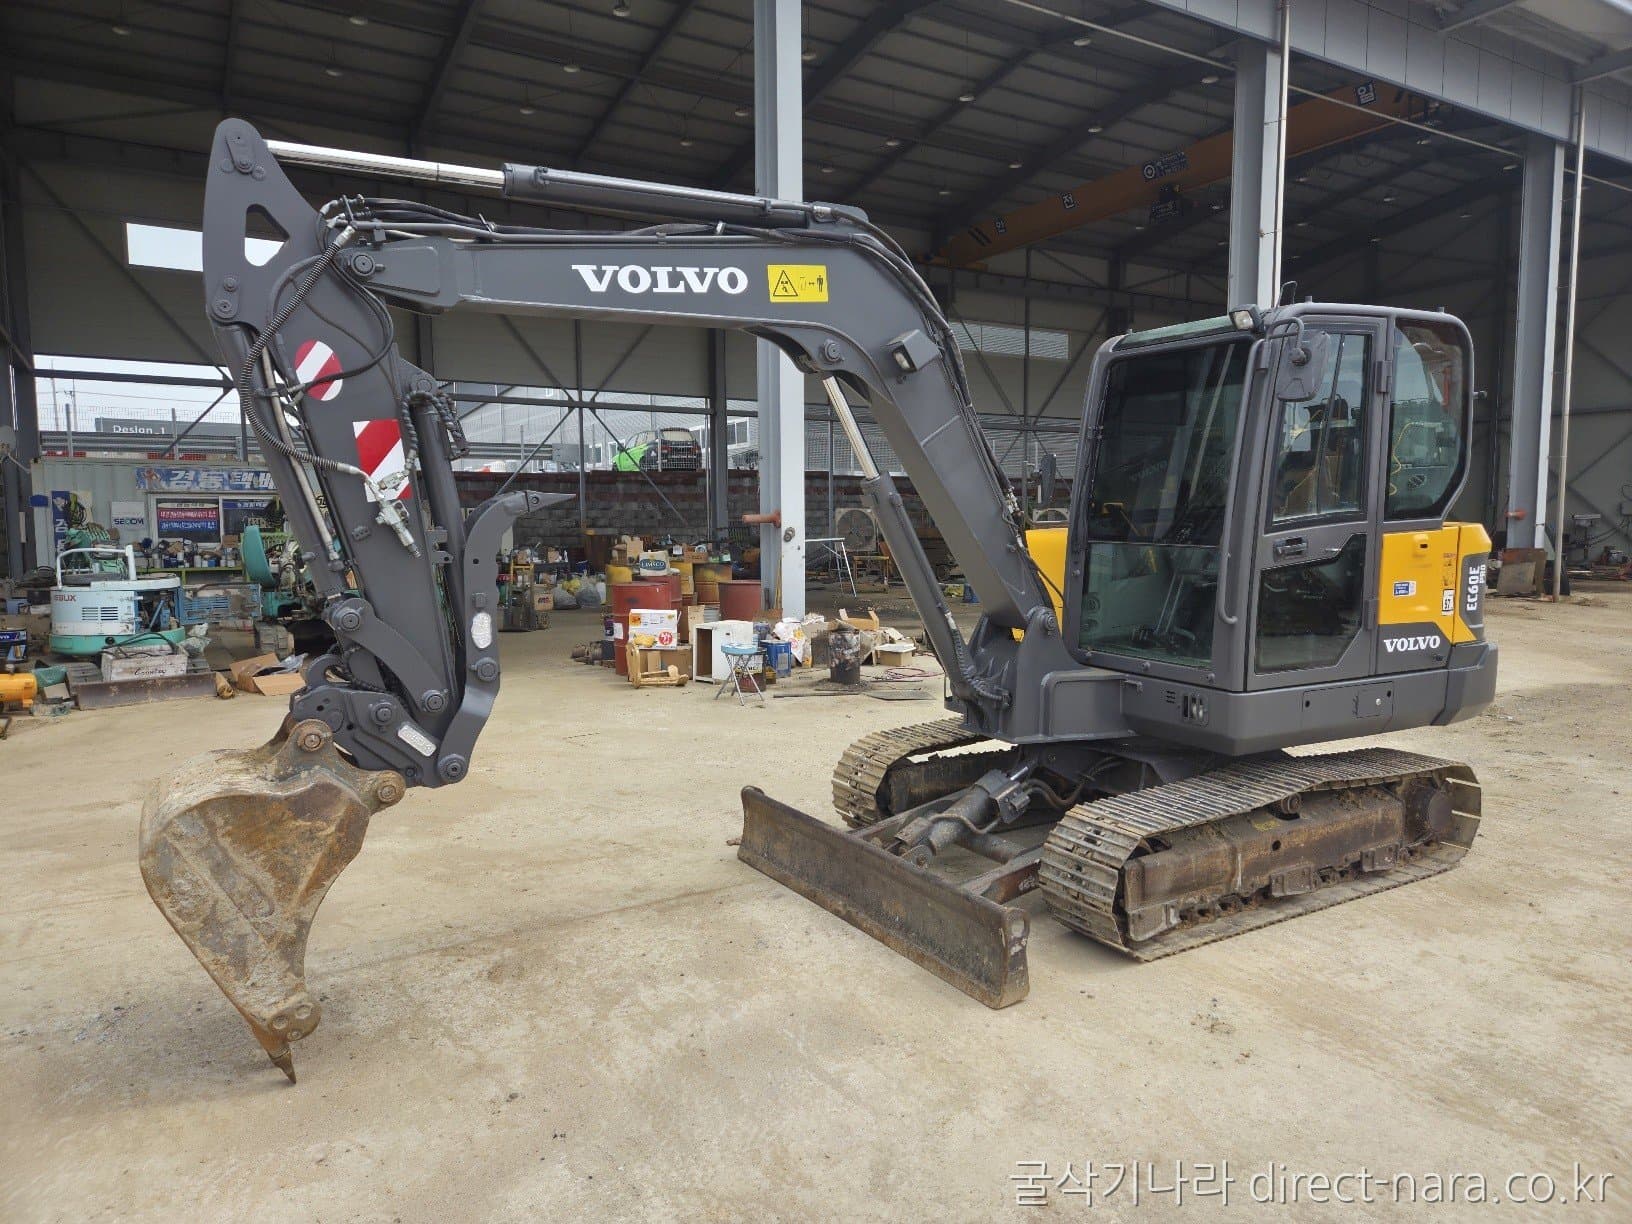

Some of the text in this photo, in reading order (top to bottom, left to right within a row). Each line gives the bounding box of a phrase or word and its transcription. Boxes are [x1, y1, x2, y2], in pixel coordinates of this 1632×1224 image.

[571, 264, 749, 295] VOLVO
[114, 517, 144, 525] SECOM
[1479, 564, 1487, 584] PRO
[1466, 566, 1480, 611] EC60E
[1383, 635, 1441, 653] VOLVO
